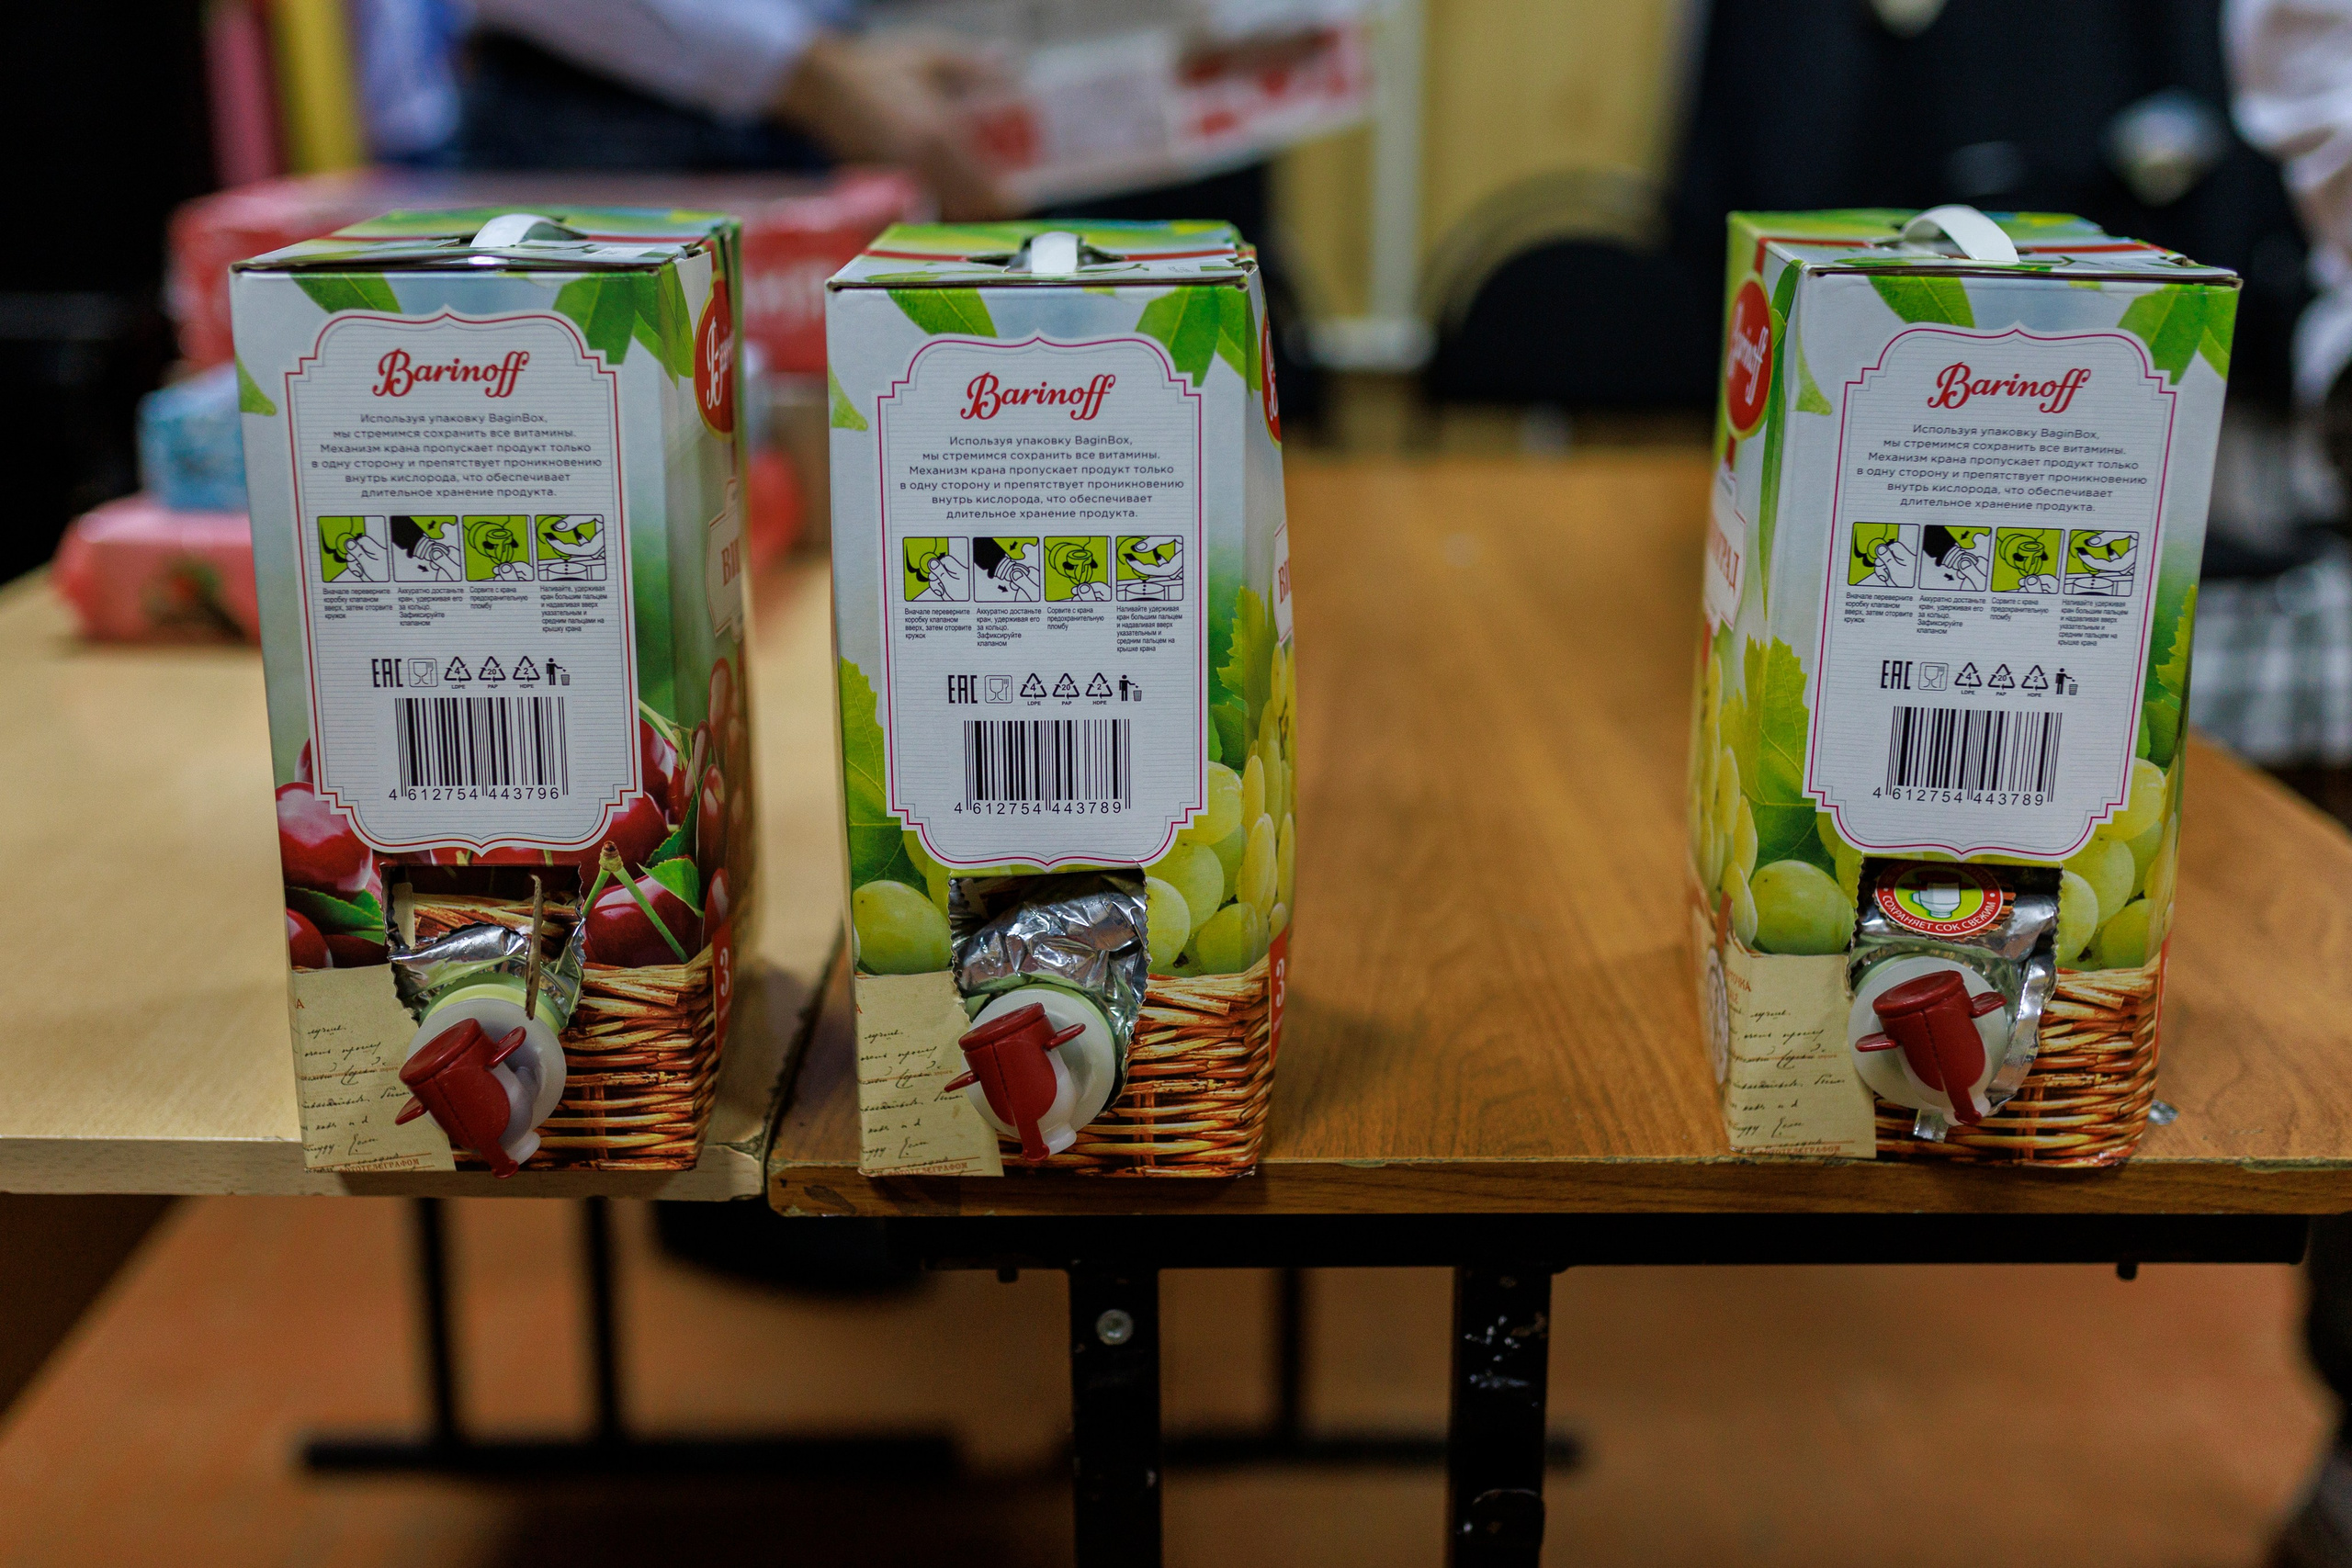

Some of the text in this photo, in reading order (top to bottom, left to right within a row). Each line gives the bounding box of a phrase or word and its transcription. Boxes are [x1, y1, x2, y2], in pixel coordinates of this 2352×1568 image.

[372, 347, 530, 398] Barinoff
[1927, 361, 2091, 413] Barinoff
[960, 372, 1115, 421] Barinoff
[359, 412, 548, 424] Используя упаковку BaginBox,
[353, 430, 421, 439] стремимся
[423, 430, 487, 439] сохранить
[1913, 423, 2099, 440] Используя упаковку BaginBox,
[949, 434, 1132, 447] Используя упаковку BaginBox,
[320, 444, 592, 454] Механизм крана пропускает продукт только
[1903, 440, 1970, 449] стремимся
[1973, 442, 2036, 452] сохранить
[2039, 445, 2060, 453] все
[2063, 446, 2126, 455] витамины.
[942, 452, 1007, 462] стремимся
[1010, 452, 1072, 461] сохранить
[1098, 451, 1159, 459] витамины.
[1868, 452, 2139, 469] Механизм крана пропускает продукт только
[311, 460, 319, 468] в
[321, 460, 351, 469] одну
[353, 460, 405, 469] сторону
[418, 459, 501, 468] препятствует
[503, 458, 602, 468] проникновению
[909, 466, 1174, 476] Механизм крана пропускает продукт только
[1866, 468, 1895, 478] одну
[1898, 468, 1949, 479] сторону
[1962, 471, 2045, 482] препятствует
[2048, 474, 2147, 485] проникновению
[345, 472, 571, 484] внутрь кислорода, что обеспечивает
[909, 481, 938, 491] одну
[941, 481, 990, 491] сторону
[1003, 480, 1084, 491] препятствует
[1087, 480, 1184, 491] проникновению
[1887, 482, 2113, 498] внутрь кислорода, что обеспечивает
[360, 489, 557, 498] длительное хранение продукта.
[932, 493, 1152, 506] внутрь кислорода, что обеспечивает
[1899, 498, 2096, 513] длительное хранение продукта.
[945, 510, 1137, 520] длительное хранение продукта.
[904, 607, 931, 615] Вначале
[976, 607, 1009, 616] Аккуратно
[1046, 606, 1071, 615] Сорвите
[1148, 605, 1179, 614] удерживая
[904, 615, 929, 625] коробку
[1046, 622, 1069, 631] пломбу
[977, 631, 1022, 640] Зафиксируйте
[371, 658, 404, 688] EAC
[1880, 660, 1913, 690] EAC
[947, 674, 978, 705] EAC
[388, 787, 560, 801] 4 612754 443796
[1872, 786, 2044, 807] 4 612754 443789
[954, 801, 1122, 815] 4 612754 443789
[1882, 894, 1996, 932] СОХРАНЯЕТ СОК СВЕЖИМ
